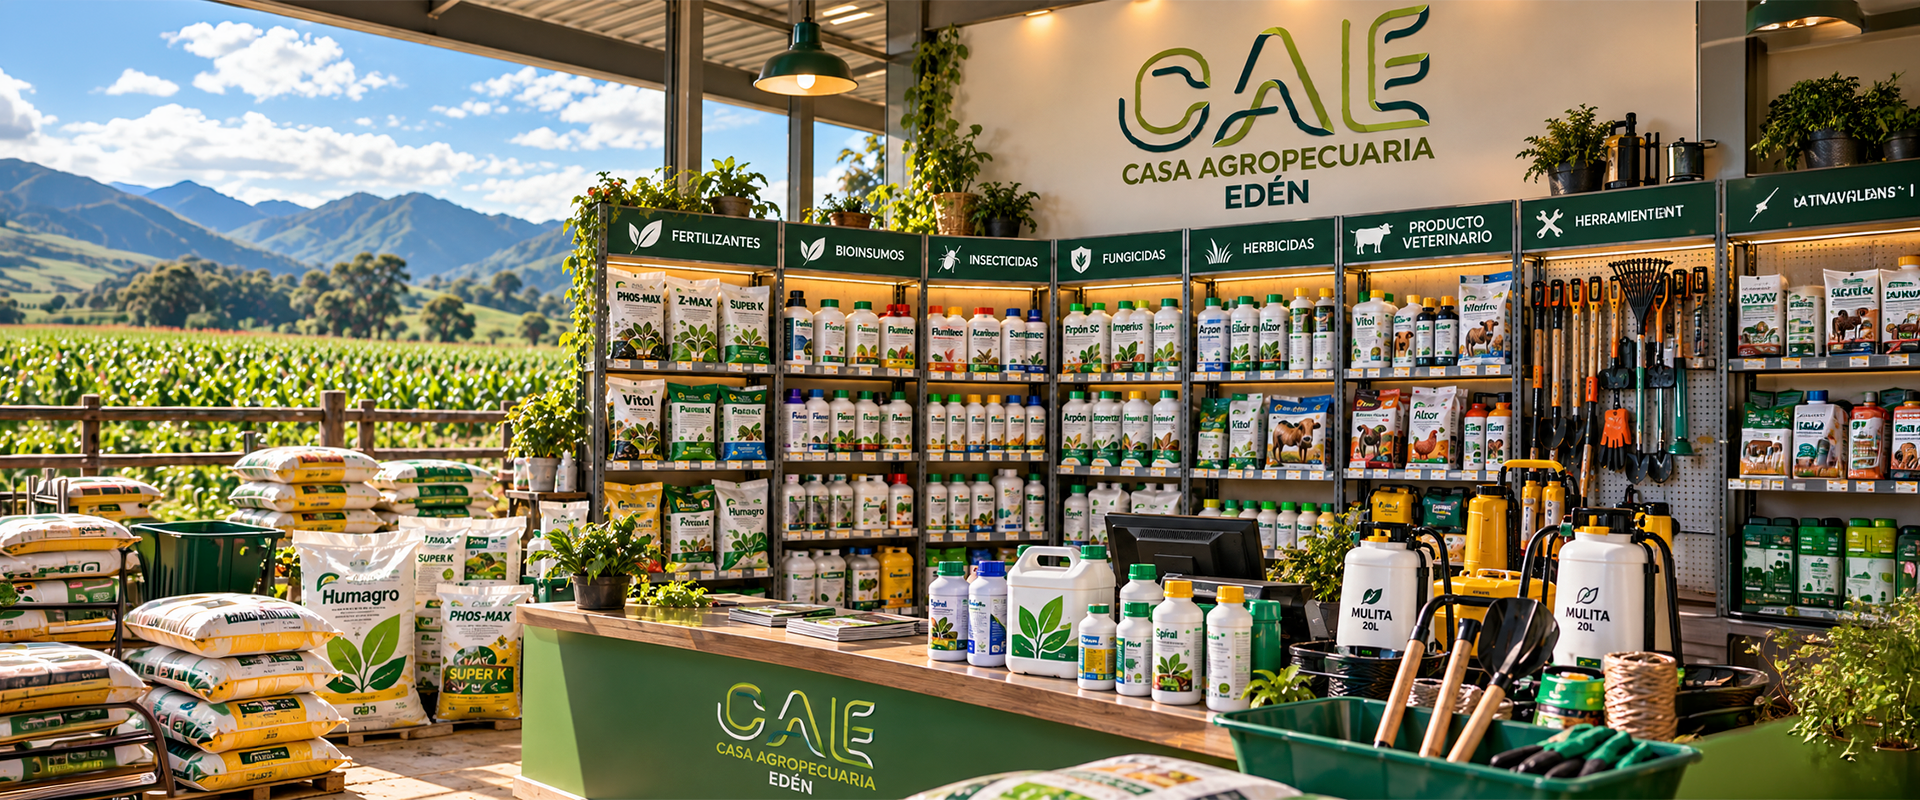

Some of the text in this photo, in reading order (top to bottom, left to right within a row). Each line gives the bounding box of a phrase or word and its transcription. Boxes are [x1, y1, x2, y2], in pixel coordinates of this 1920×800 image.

[1122, 137, 1435, 185] CASA AGROPECUARIA
[1225, 175, 1309, 210] EDÉN
[1409, 215, 1485, 234] PRODUCTO
[672, 229, 761, 249] FERTILIZANTES
[1402, 230, 1493, 249] VETERINARIO
[1243, 238, 1315, 254] HERBICIDAS
[836, 245, 905, 261] BIOINSUMOS
[1102, 249, 1166, 264] FUNGICIDAS
[969, 254, 1038, 267] INSECTICIDAS
[617, 291, 661, 304] PHOS-MAX
[678, 295, 713, 307] Z-MAX
[730, 300, 764, 311] SUPER K
[1355, 316, 1375, 327] Vitol
[1090, 324, 1099, 333] SC
[622, 394, 654, 407] Vitol
[1064, 413, 1086, 423] Arpón
[728, 507, 764, 518] Humagro
[418, 554, 454, 563] SUPER K
[322, 589, 399, 605] Humagro
[449, 610, 512, 622] PHOS-MAX
[1351, 607, 1392, 621] MULITA
[1566, 606, 1610, 622] MULITA
[1362, 622, 1379, 631] 20L
[1577, 622, 1595, 632] 20L
[1156, 628, 1178, 640] Spiral
[449, 667, 507, 681] SUPER K
[716, 742, 876, 791] CASA AGROPECUARIA
[769, 771, 813, 795] EDÉN
